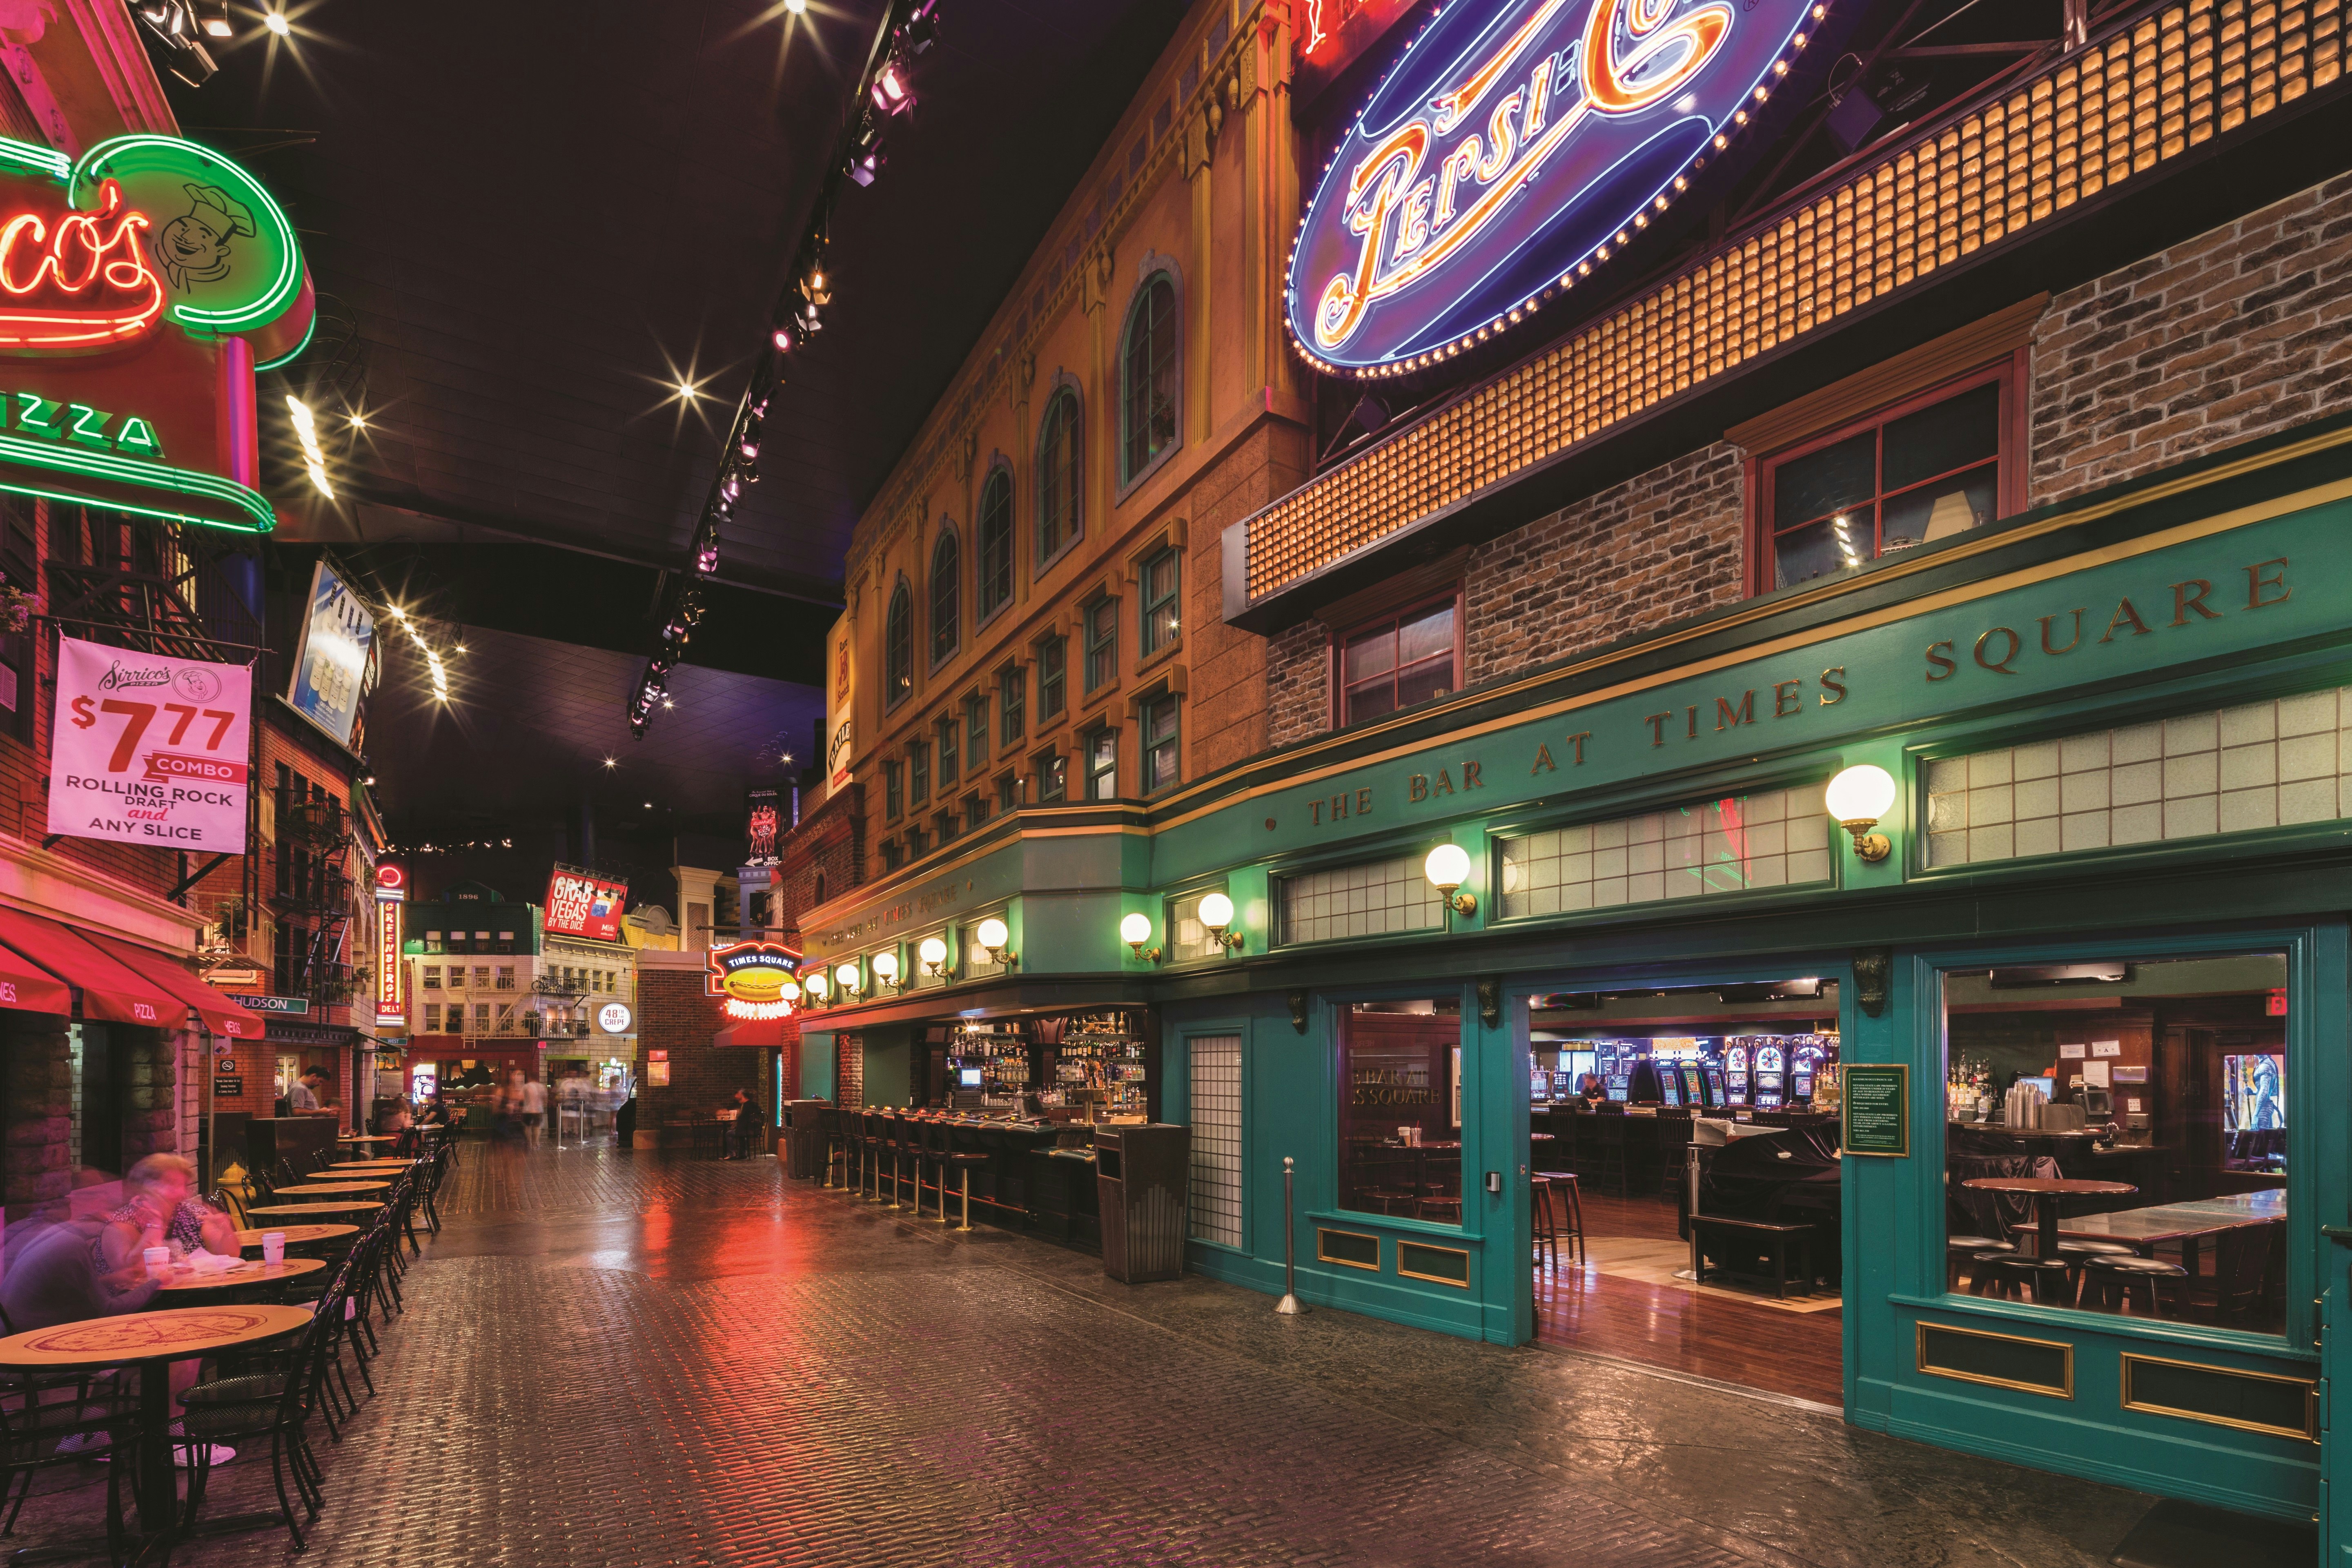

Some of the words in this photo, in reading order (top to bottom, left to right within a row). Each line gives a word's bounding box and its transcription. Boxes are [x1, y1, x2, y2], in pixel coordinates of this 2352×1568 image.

[0, 177, 150, 293] co's
[98, 660, 172, 692] Sirrico's
[1307, 786, 1372, 826] THE
[1408, 760, 1485, 804] BAR
[1530, 731, 1592, 774] AT
[1644, 665, 1848, 747] TIMES
[1925, 557, 2293, 683] SQUARE
[830, 722, 851, 768] BAILE
[156, 758, 233, 778] COMBO
[66, 775, 163, 798] ROLLING
[172, 787, 234, 807] ROCK
[125, 796, 177, 810] DRAFT
[127, 808, 168, 822] and
[88, 817, 136, 834] ANY
[143, 823, 203, 841] SLICE
[554, 876, 593, 903] GRAB
[551, 898, 588, 921] VEGAS
[830, 930, 844, 946] THE
[846, 922, 863, 940] BAR
[867, 915, 879, 932] AT
[883, 902, 912, 925] TIMES
[917, 883, 957, 914] SQUARE
[548, 917, 558, 927] BY
[558, 919, 569, 929] THE
[569, 920, 584, 931] DICE
[385, 902, 394, 1002] GREENBERGS
[728, 956, 757, 967] TIMES
[759, 956, 794, 969] SQUARE
[134, 1003, 157, 1020] PIZZA
[234, 996, 287, 1009] HUDSON
[2271, 996, 2287, 1014] EX
[1365, 1069, 1401, 1085] BAR
[1406, 1069, 1428, 1085] AT
[1370, 1088, 1441, 1106] SQUARE
